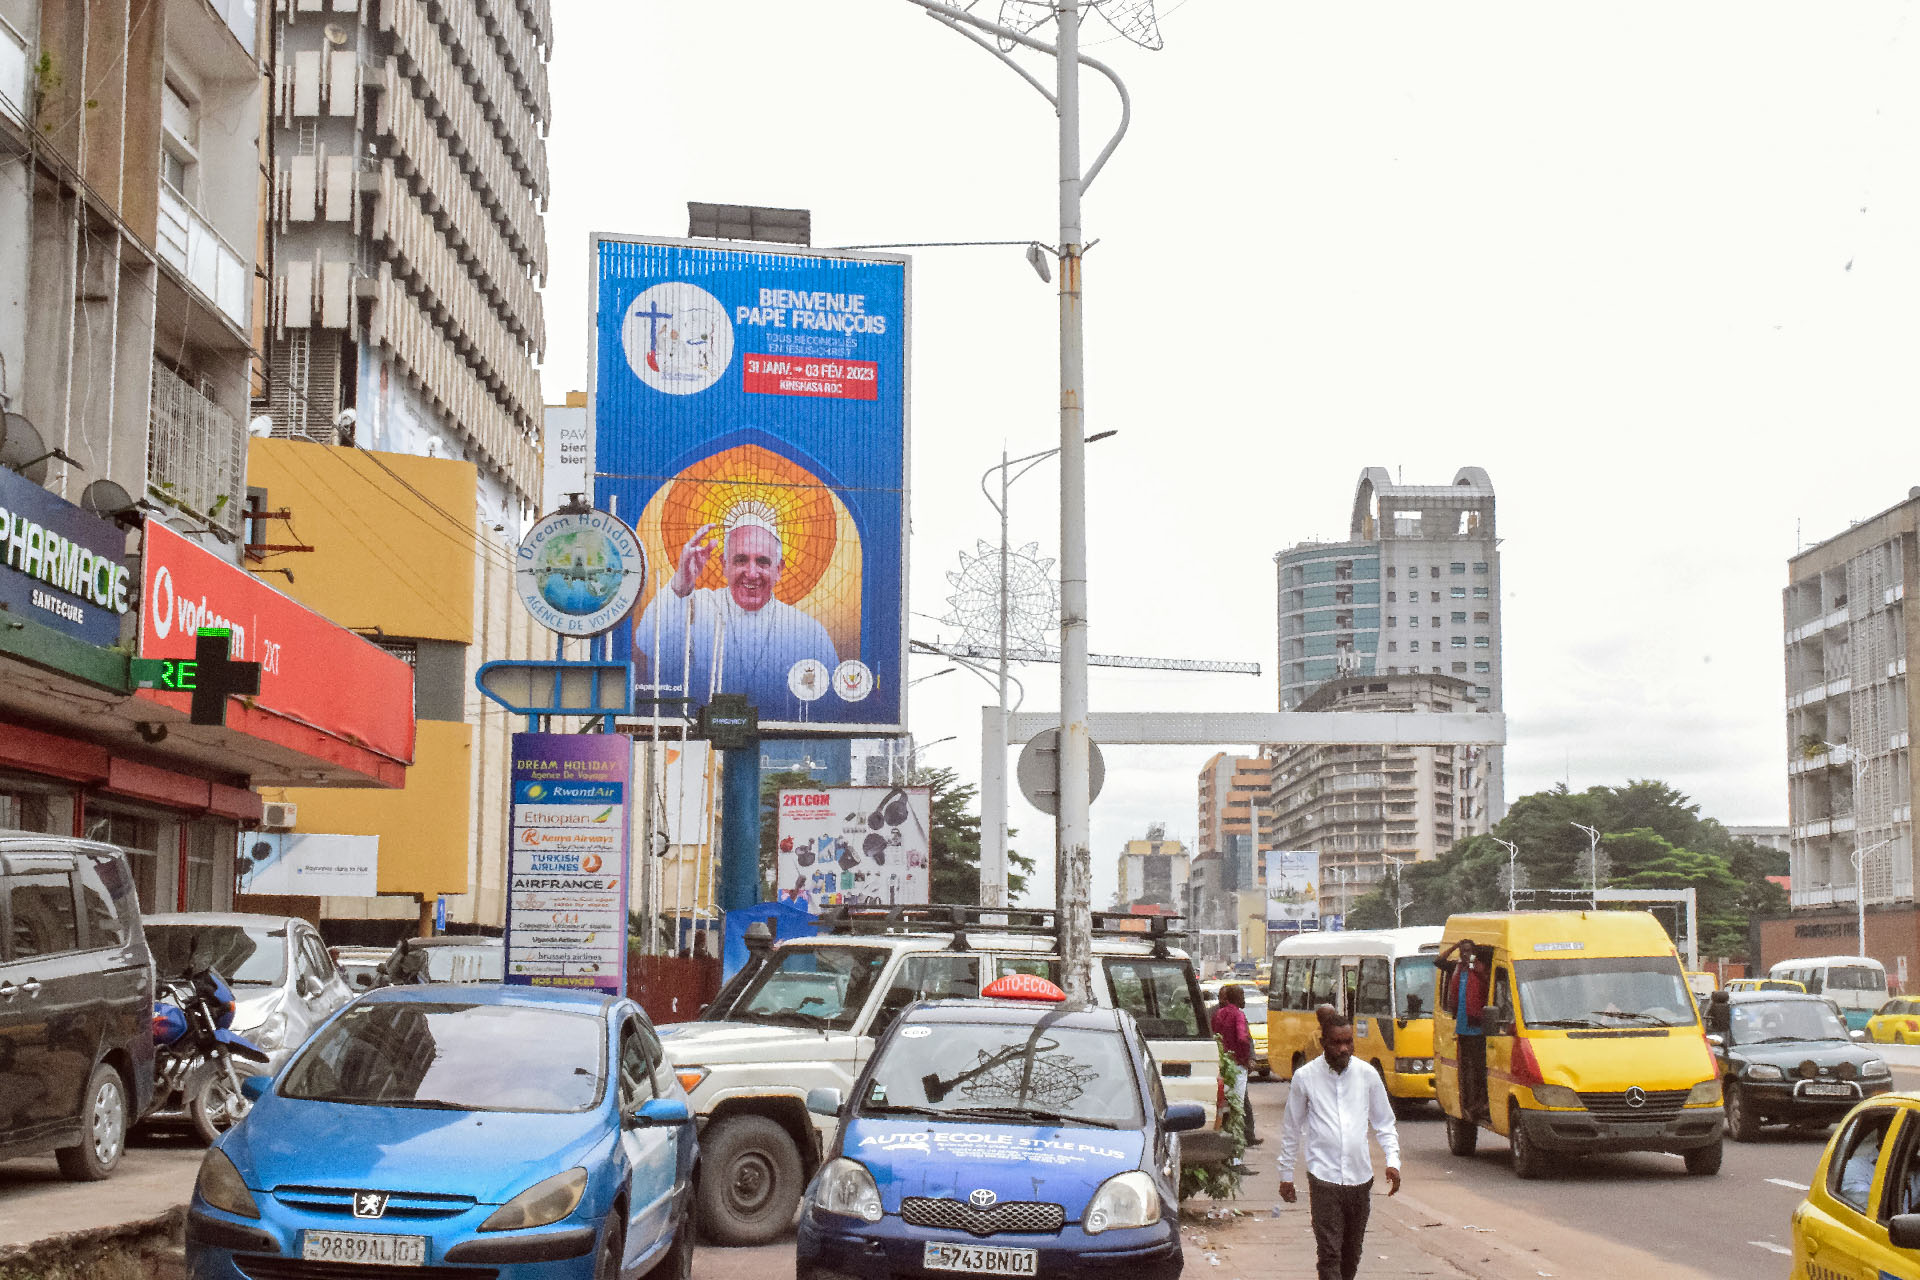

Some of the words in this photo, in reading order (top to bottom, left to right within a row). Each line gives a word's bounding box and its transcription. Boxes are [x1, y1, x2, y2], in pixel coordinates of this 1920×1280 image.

[759, 288, 865, 314] BIENVENUE
[736, 306, 786, 328] PAPE
[792, 310, 886, 337] FRANÇOIS
[766, 332, 792, 345] TOUS
[769, 344, 782, 353] EN
[748, 360, 760, 374] 31
[762, 360, 793, 376] JANV.
[805, 364, 819, 378] 03
[821, 362, 845, 379] FÉV.
[846, 366, 875, 381] 2023
[780, 380, 823, 393] KINSHASA
[824, 383, 843, 394] RDC
[518, 517, 570, 560] Dream
[579, 513, 635, 560] Holiday
[0, 507, 130, 615] PHARMACIE
[32, 589, 84, 625] SANTECURE
[526, 595, 563, 629] AGENCE
[568, 619, 583, 631] DE
[589, 595, 628, 629] VOYAGE
[263, 639, 281, 676] 2XT
[517, 760, 558, 770] DREAM
[564, 760, 617, 771] HOLIDAY
[563, 770, 575, 779] De
[782, 794, 830, 806] 2XT.COM
[524, 811, 590, 825] Ethiopian
[541, 834, 573, 843] Kenya
[574, 834, 614, 844] Airways
[531, 854, 580, 863] TURKISH
[530, 863, 579, 872] AIRLINES
[514, 879, 603, 889] AIRFRANCE
[538, 952, 570, 960] brussels
[572, 952, 602, 961] airlines
[531, 977, 552, 986] NOS
[553, 977, 594, 986] SERVICES
[991, 976, 1059, 997] AUTO-ECOLE
[858, 1132, 929, 1147] AUTO
[934, 1133, 1012, 1145] ECOLE
[1019, 1138, 1075, 1151] STYLE
[1078, 1144, 1126, 1160] PLUS
